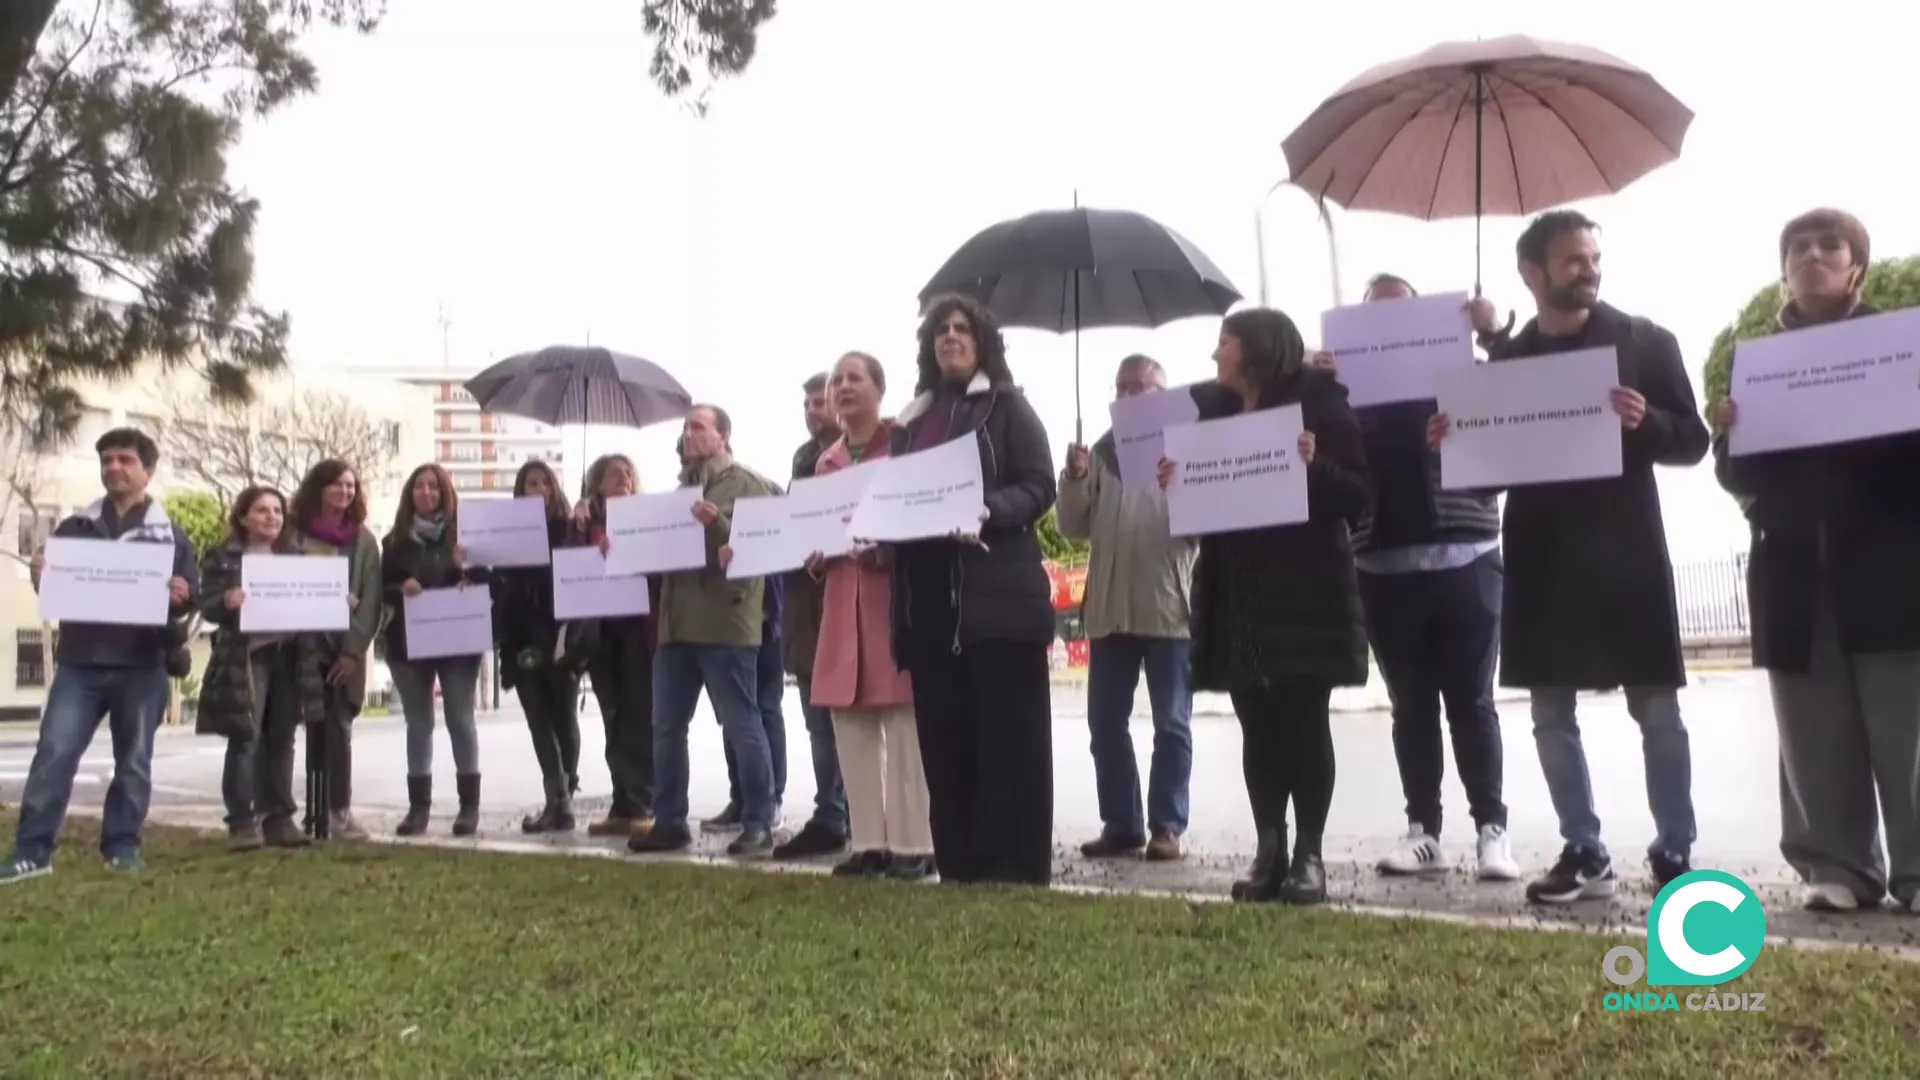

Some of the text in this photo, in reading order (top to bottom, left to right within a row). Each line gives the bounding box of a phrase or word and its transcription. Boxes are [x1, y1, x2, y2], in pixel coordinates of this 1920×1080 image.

[1456, 416, 1490, 431] Evitar
[1494, 415, 1505, 425] la
[1185, 449, 1286, 472] Planes de igualdad en
[1183, 471, 1230, 487] empresas
